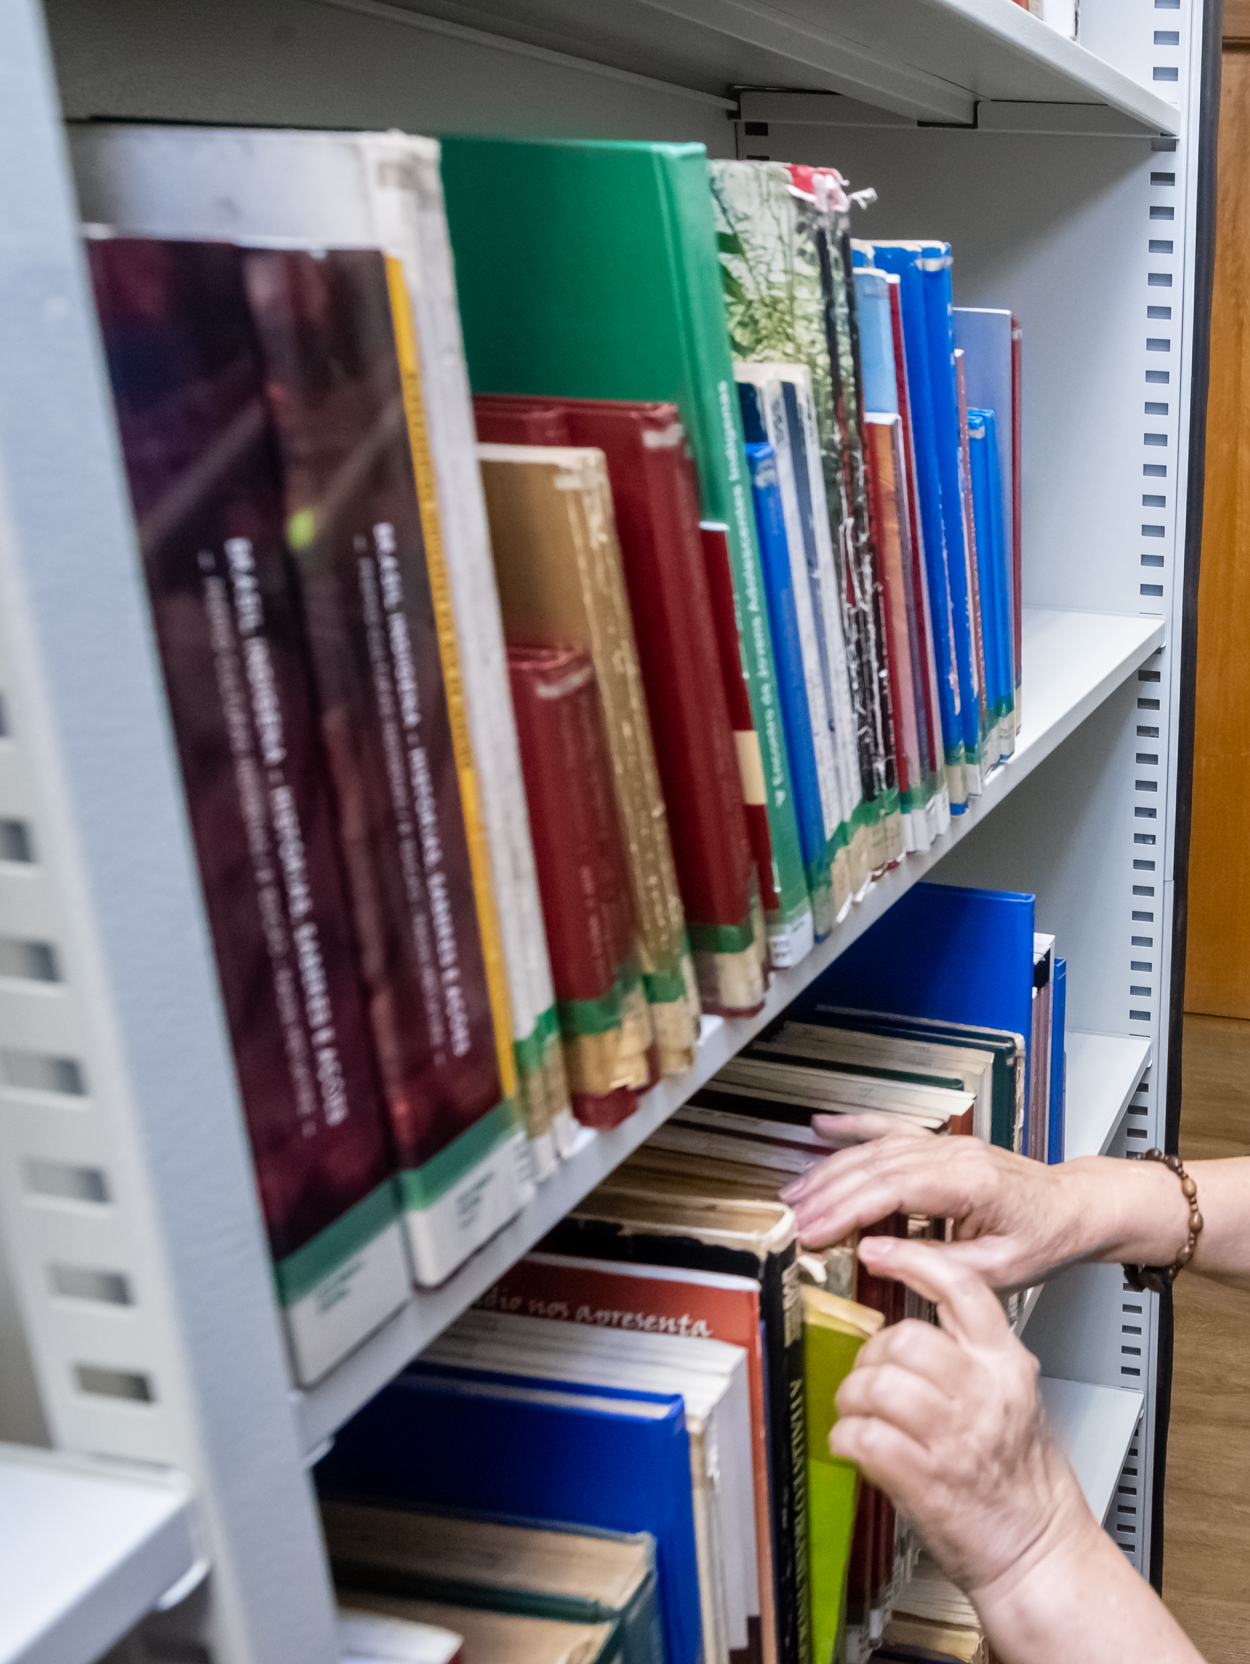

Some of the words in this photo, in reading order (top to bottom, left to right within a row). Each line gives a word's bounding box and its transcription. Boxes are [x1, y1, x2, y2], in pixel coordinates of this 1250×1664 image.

[718, 380, 741, 482] Indígenas
[733, 484, 759, 612] Adolescentes
[751, 616, 769, 680] Jovens
[575, 1304, 714, 1338] apresenta
